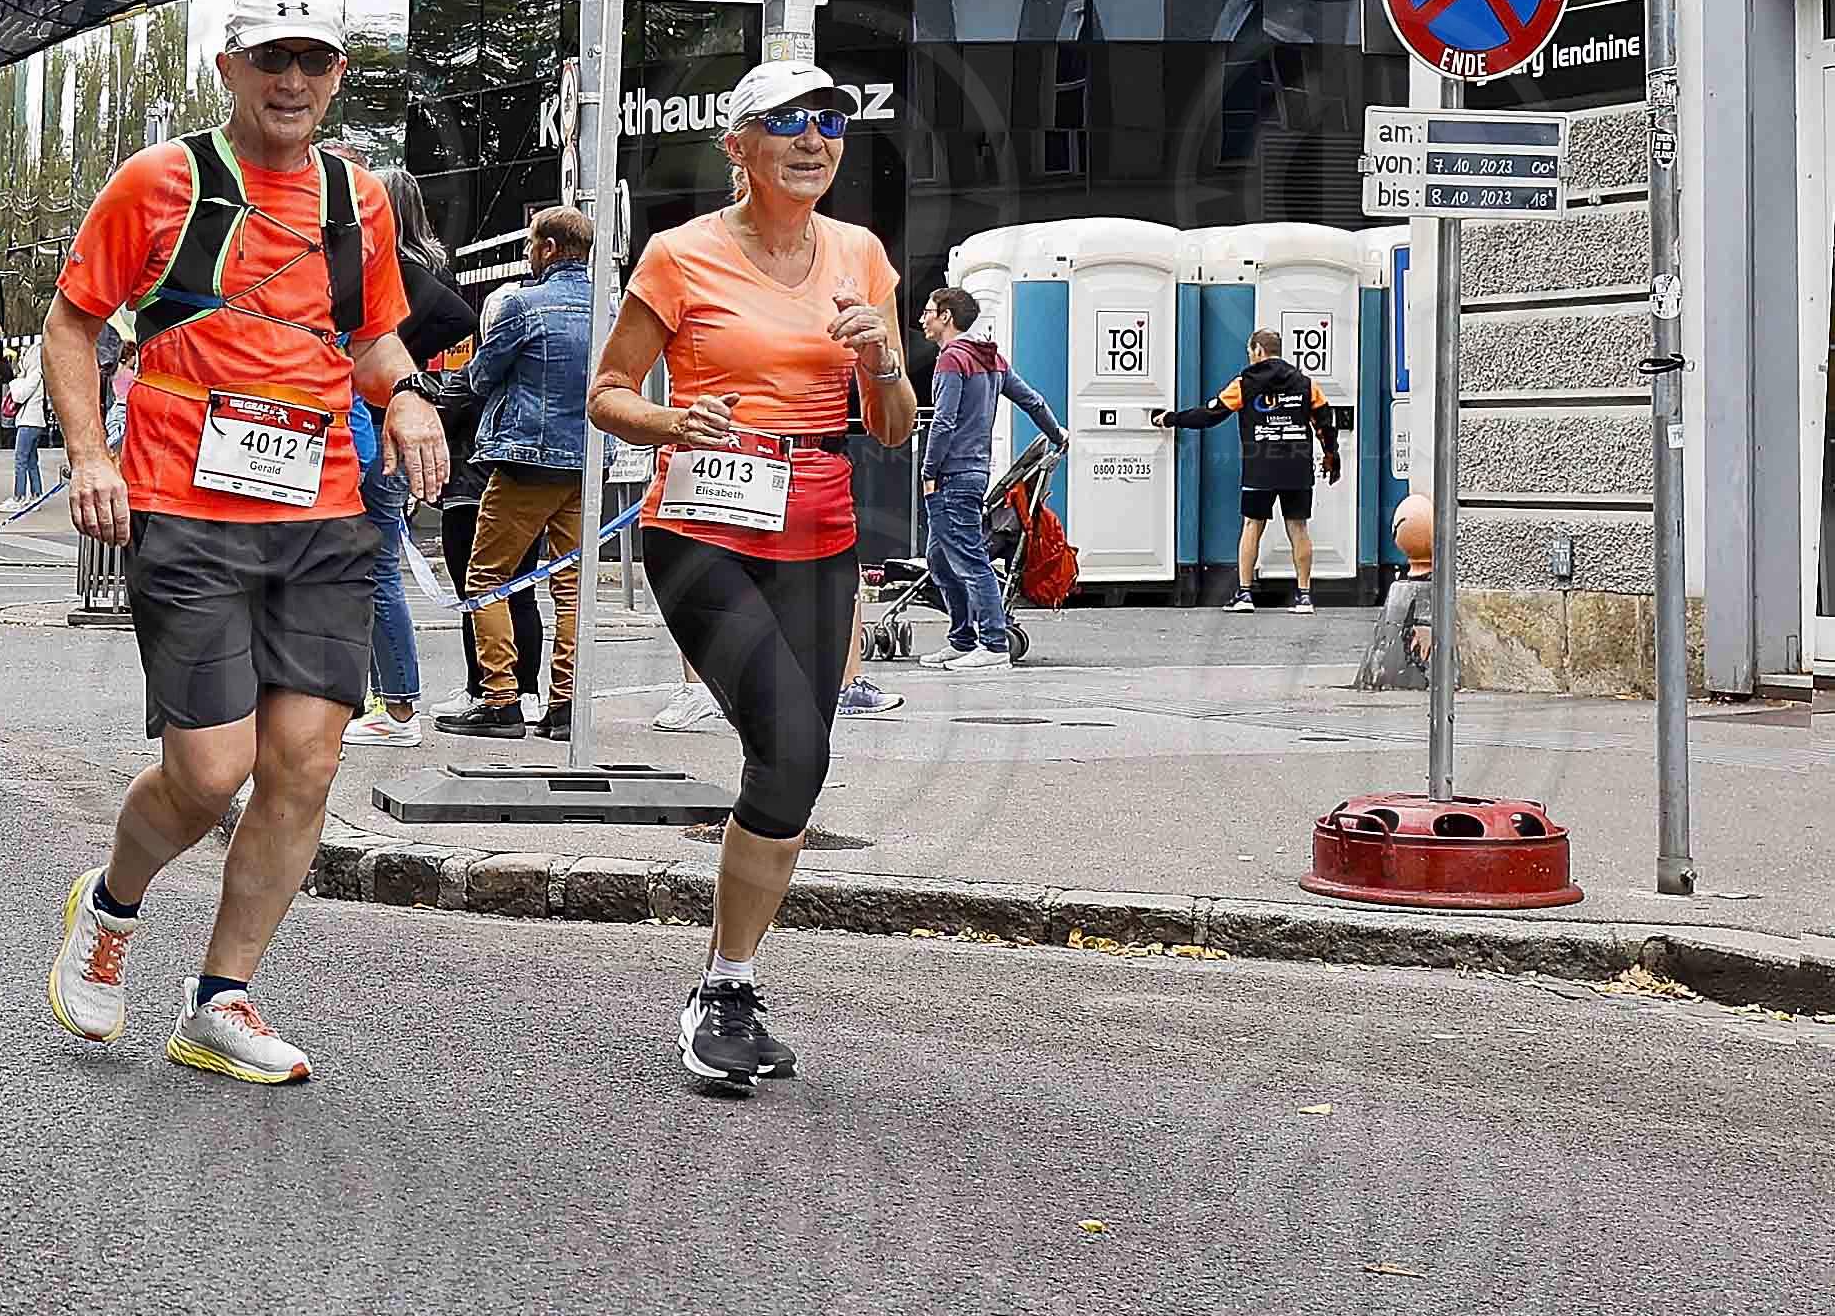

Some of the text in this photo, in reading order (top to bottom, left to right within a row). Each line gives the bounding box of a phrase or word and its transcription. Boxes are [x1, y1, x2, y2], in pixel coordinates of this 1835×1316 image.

[1439, 47, 1487, 76] ENDE
[1552, 33, 1640, 69] lendnine
[1379, 125, 1422, 144] am:
[1374, 155, 1421, 175] von:
[1377, 181, 1420, 208] bis:
[1108, 328, 1144, 349] TOI
[1292, 328, 1327, 349] TOI
[1107, 350, 1143, 372] TOI
[1292, 350, 1327, 372] TOI
[239, 429, 298, 461] 4012
[249, 460, 281, 476] Gerald
[691, 456, 753, 484] 4013
[1093, 464, 1151, 475] 0800 230 235
[694, 485, 744, 501] Elisabeth
